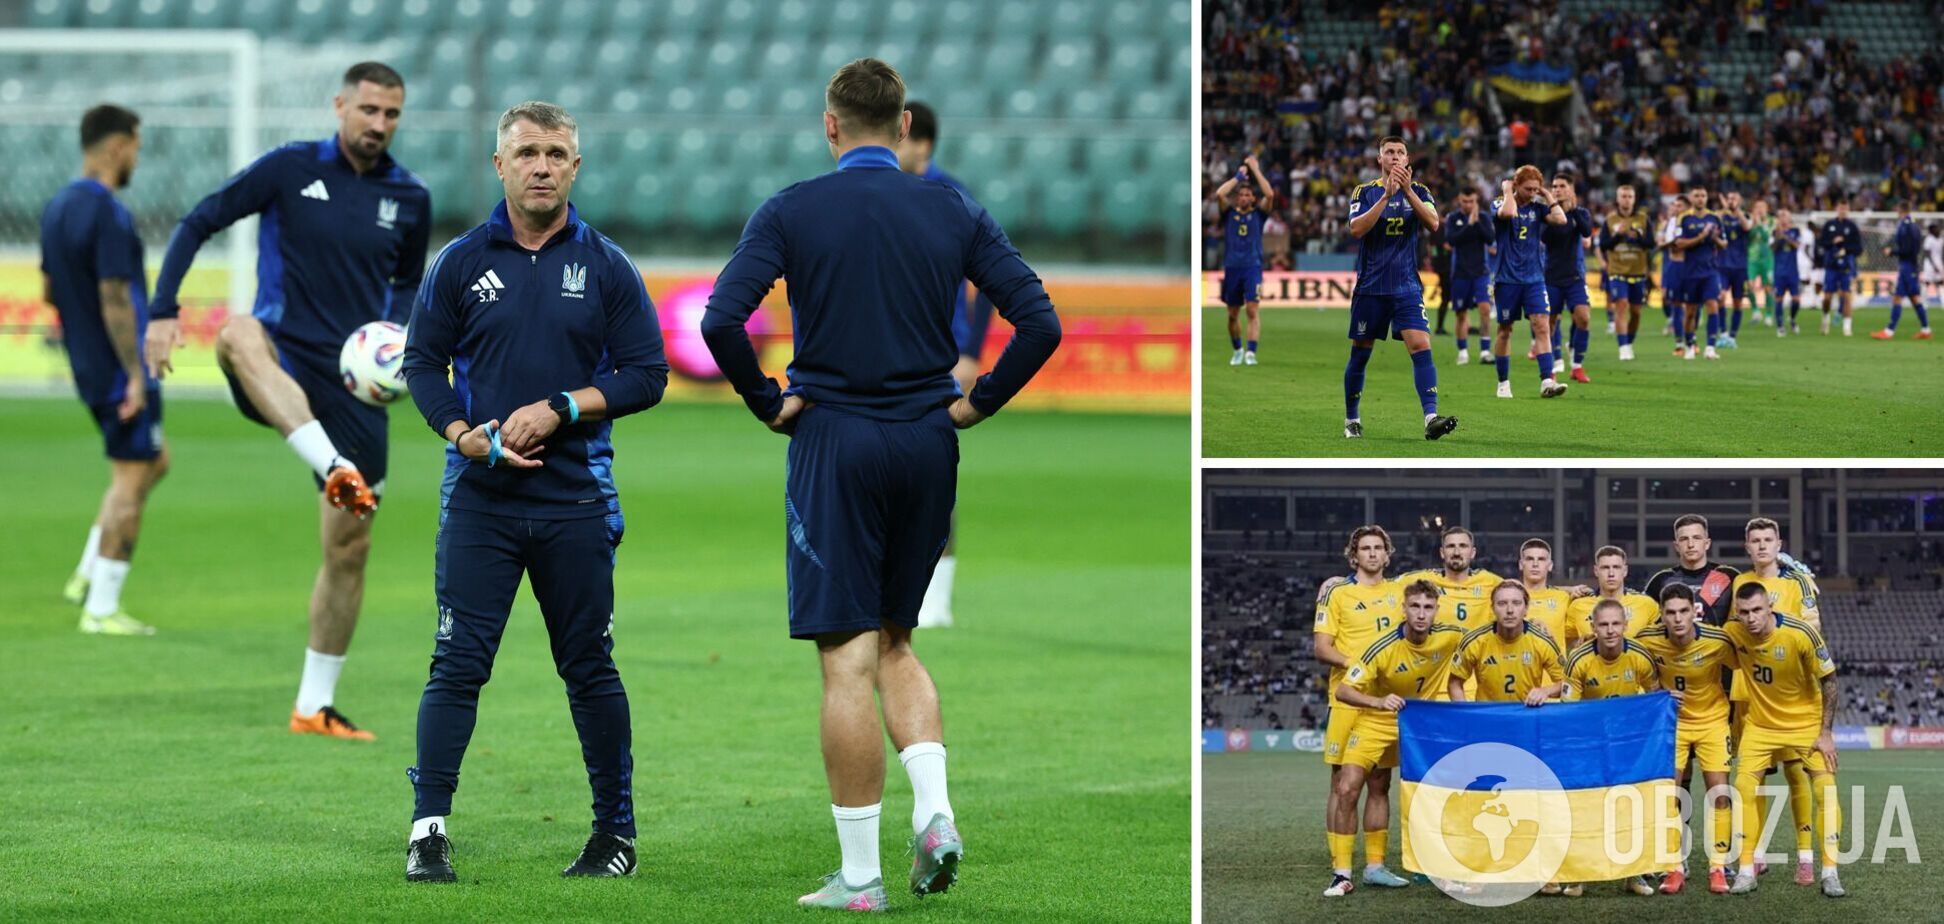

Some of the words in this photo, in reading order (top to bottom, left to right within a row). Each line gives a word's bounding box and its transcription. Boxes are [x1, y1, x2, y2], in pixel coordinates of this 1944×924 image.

[1384, 217, 1405, 236] 22
[1518, 225, 1528, 240] 2
[479, 289, 499, 303] S.R.
[1456, 602, 1467, 621] 6
[1753, 663, 1774, 685] 20
[1416, 676, 1426, 694] 7
[1504, 674, 1516, 694] 2
[1674, 675, 1686, 692] 8
